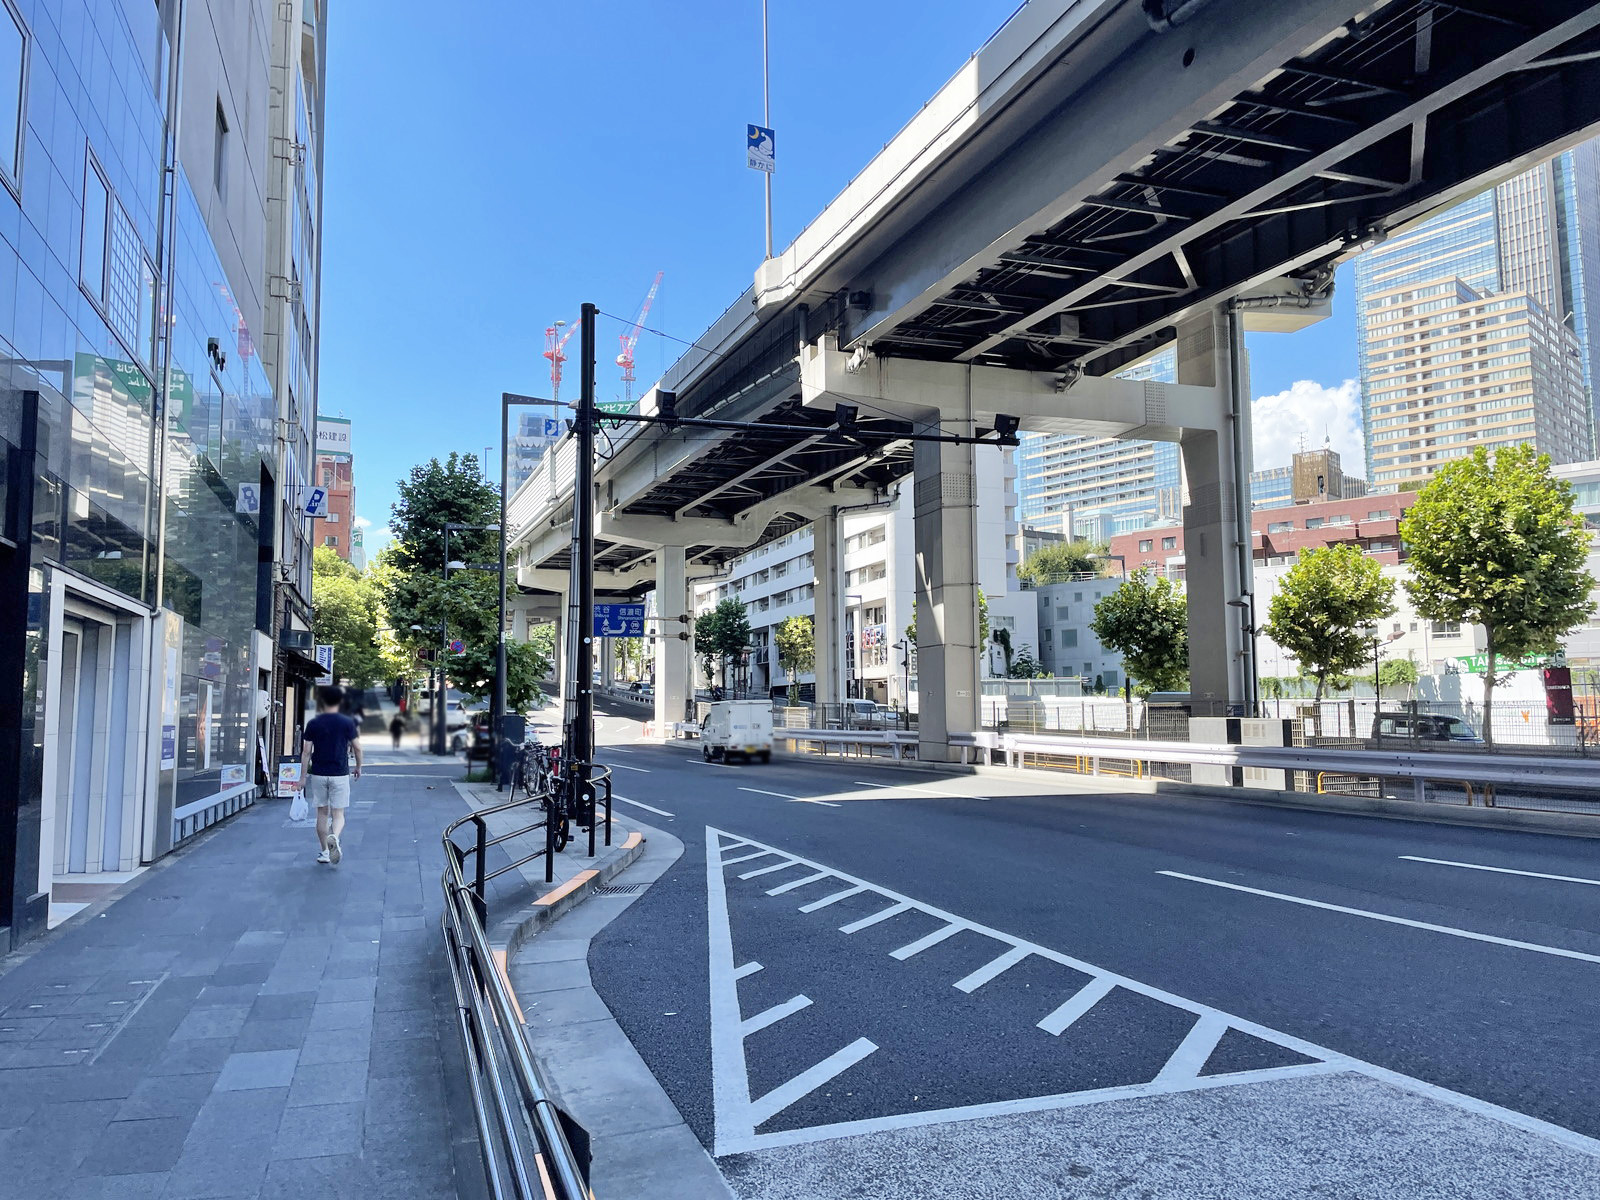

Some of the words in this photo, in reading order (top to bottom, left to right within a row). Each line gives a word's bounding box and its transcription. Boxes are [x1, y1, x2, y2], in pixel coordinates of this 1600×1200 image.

[750, 159, 773, 171] 静かに
[316, 430, 347, 442] 松建設
